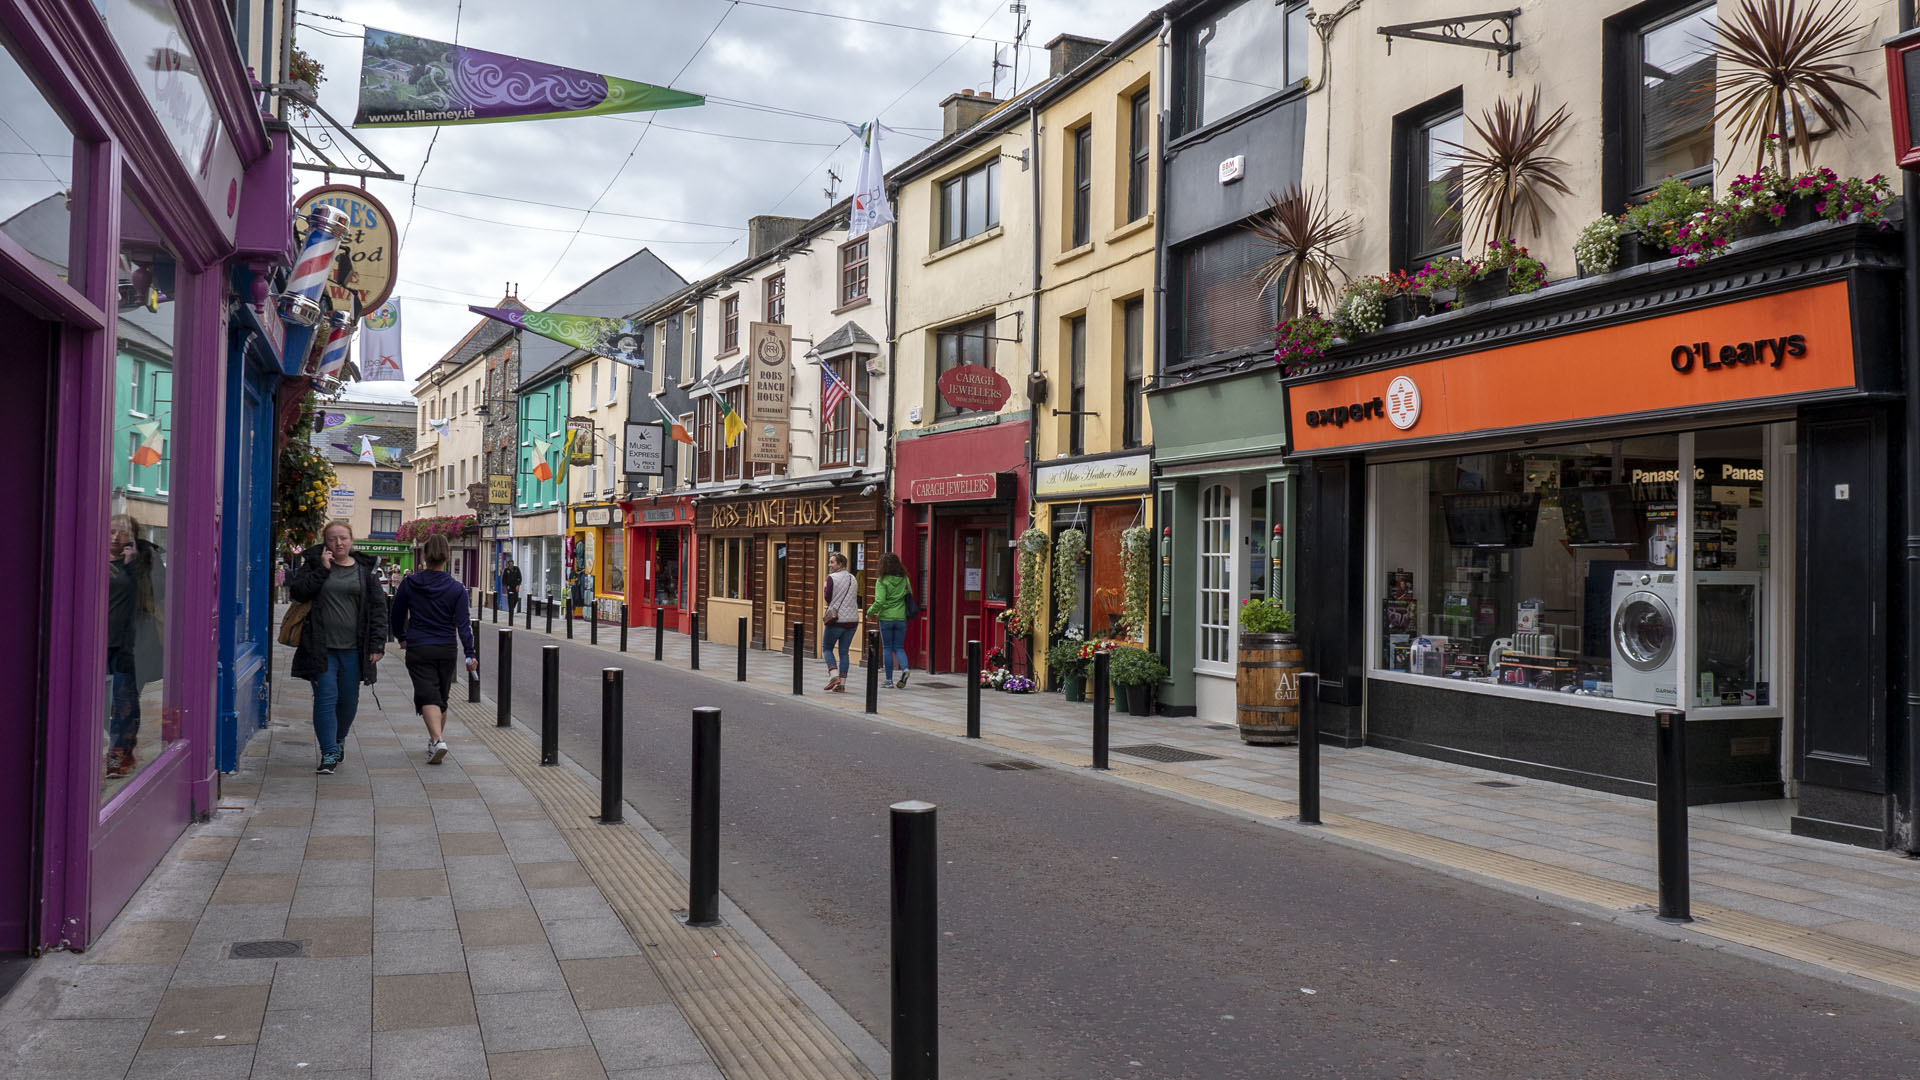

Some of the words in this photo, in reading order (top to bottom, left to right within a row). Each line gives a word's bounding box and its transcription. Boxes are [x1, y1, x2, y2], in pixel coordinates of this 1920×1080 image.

[368, 105, 475, 122] www.killarney.ie
[1671, 335, 1807, 373] O'Learys
[760, 371, 783, 381] ROBS
[955, 372, 995, 386] CARAGH
[757, 381, 785, 391] RANCH
[947, 383, 1002, 399] JEWELLERS
[757, 392, 785, 403] HOUSE
[1305, 397, 1384, 427] expert
[629, 442, 653, 450] MUSIC
[629, 450, 660, 459] EXPRESS
[1112, 463, 1138, 478] Florist
[1632, 465, 1705, 484] Panasoic
[916, 482, 945, 497] CARAGH
[945, 478, 989, 497] JEWELLERS
[711, 502, 740, 529] ROBS
[746, 499, 785, 528] RANCH
[793, 495, 842, 526] HOUSE
